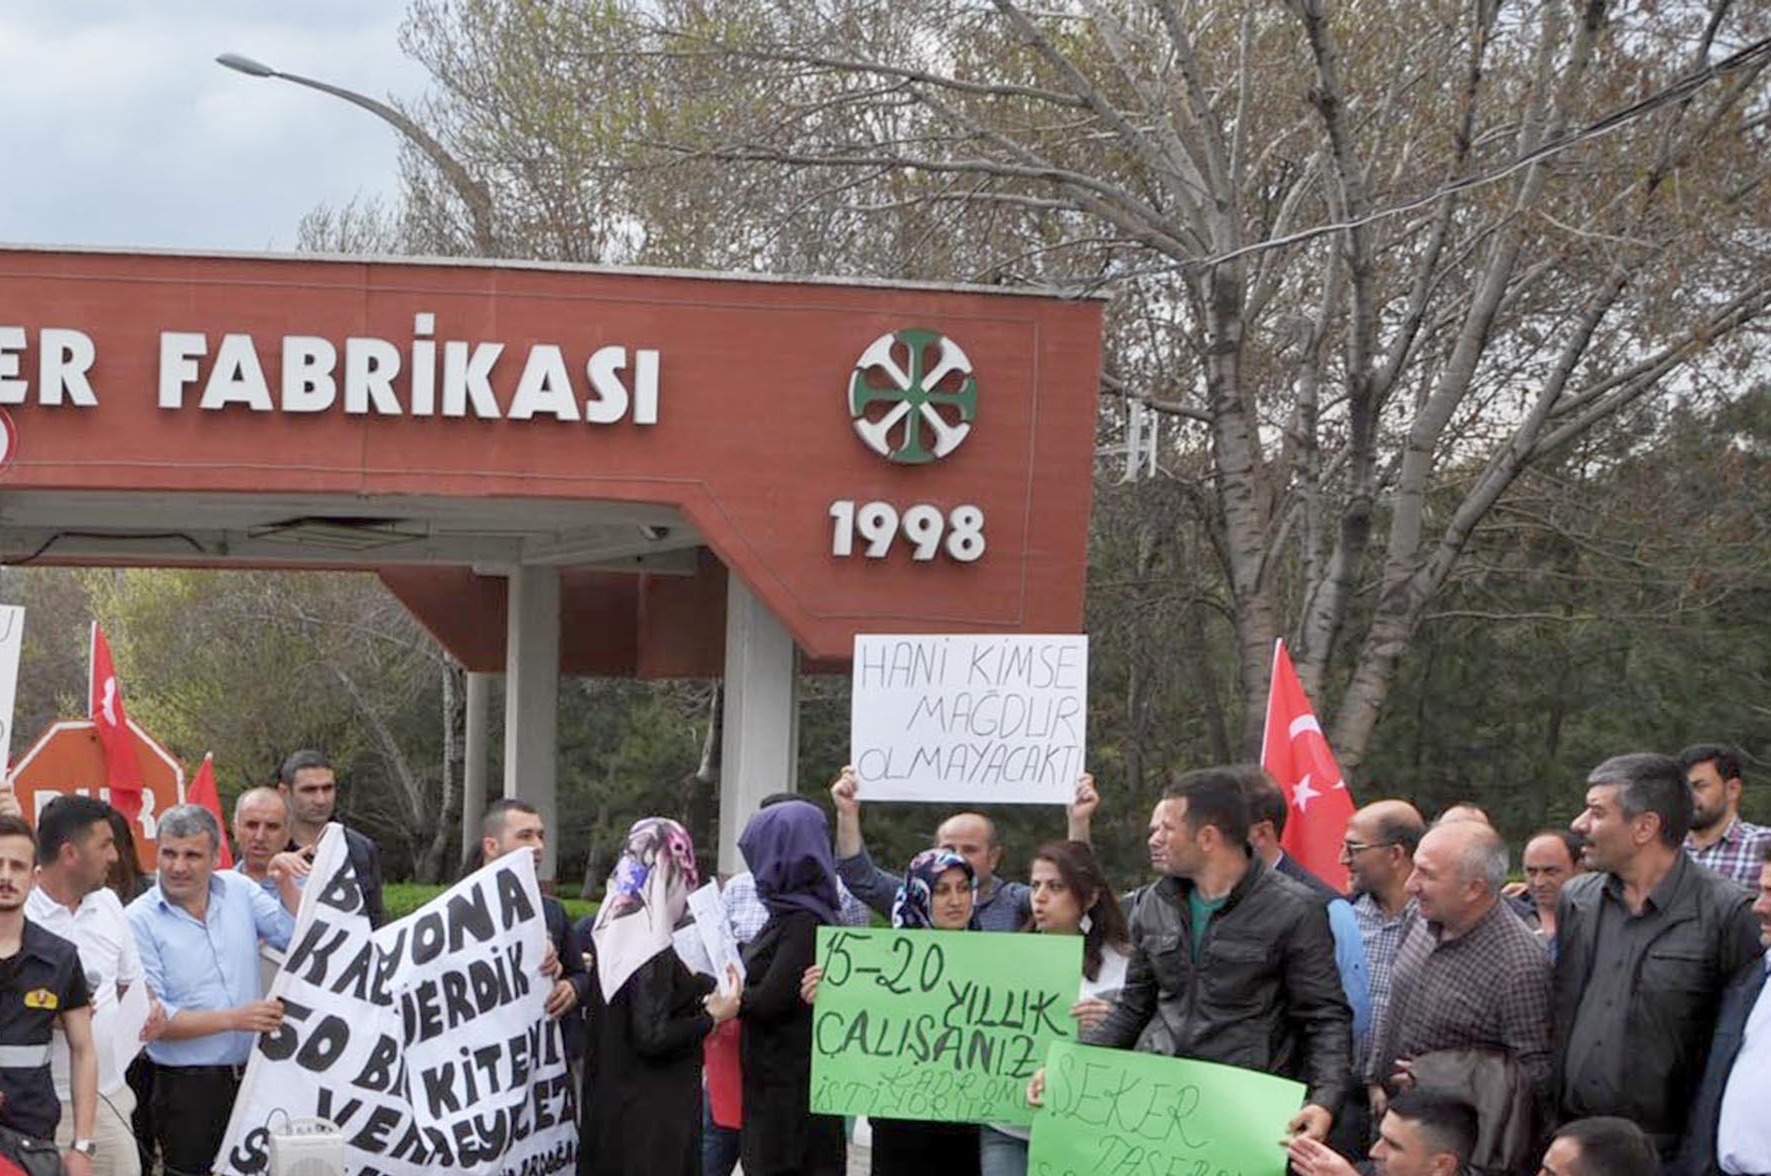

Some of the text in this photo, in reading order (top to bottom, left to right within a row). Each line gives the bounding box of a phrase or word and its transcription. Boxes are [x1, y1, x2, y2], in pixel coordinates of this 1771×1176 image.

[158, 312, 660, 425] FABRİKASI
[829, 500, 986, 562] 1998
[967, 638, 1078, 690] KİMSE
[906, 689, 1081, 742] MAĞDUR
[943, 979, 1069, 1037] YILLIK
